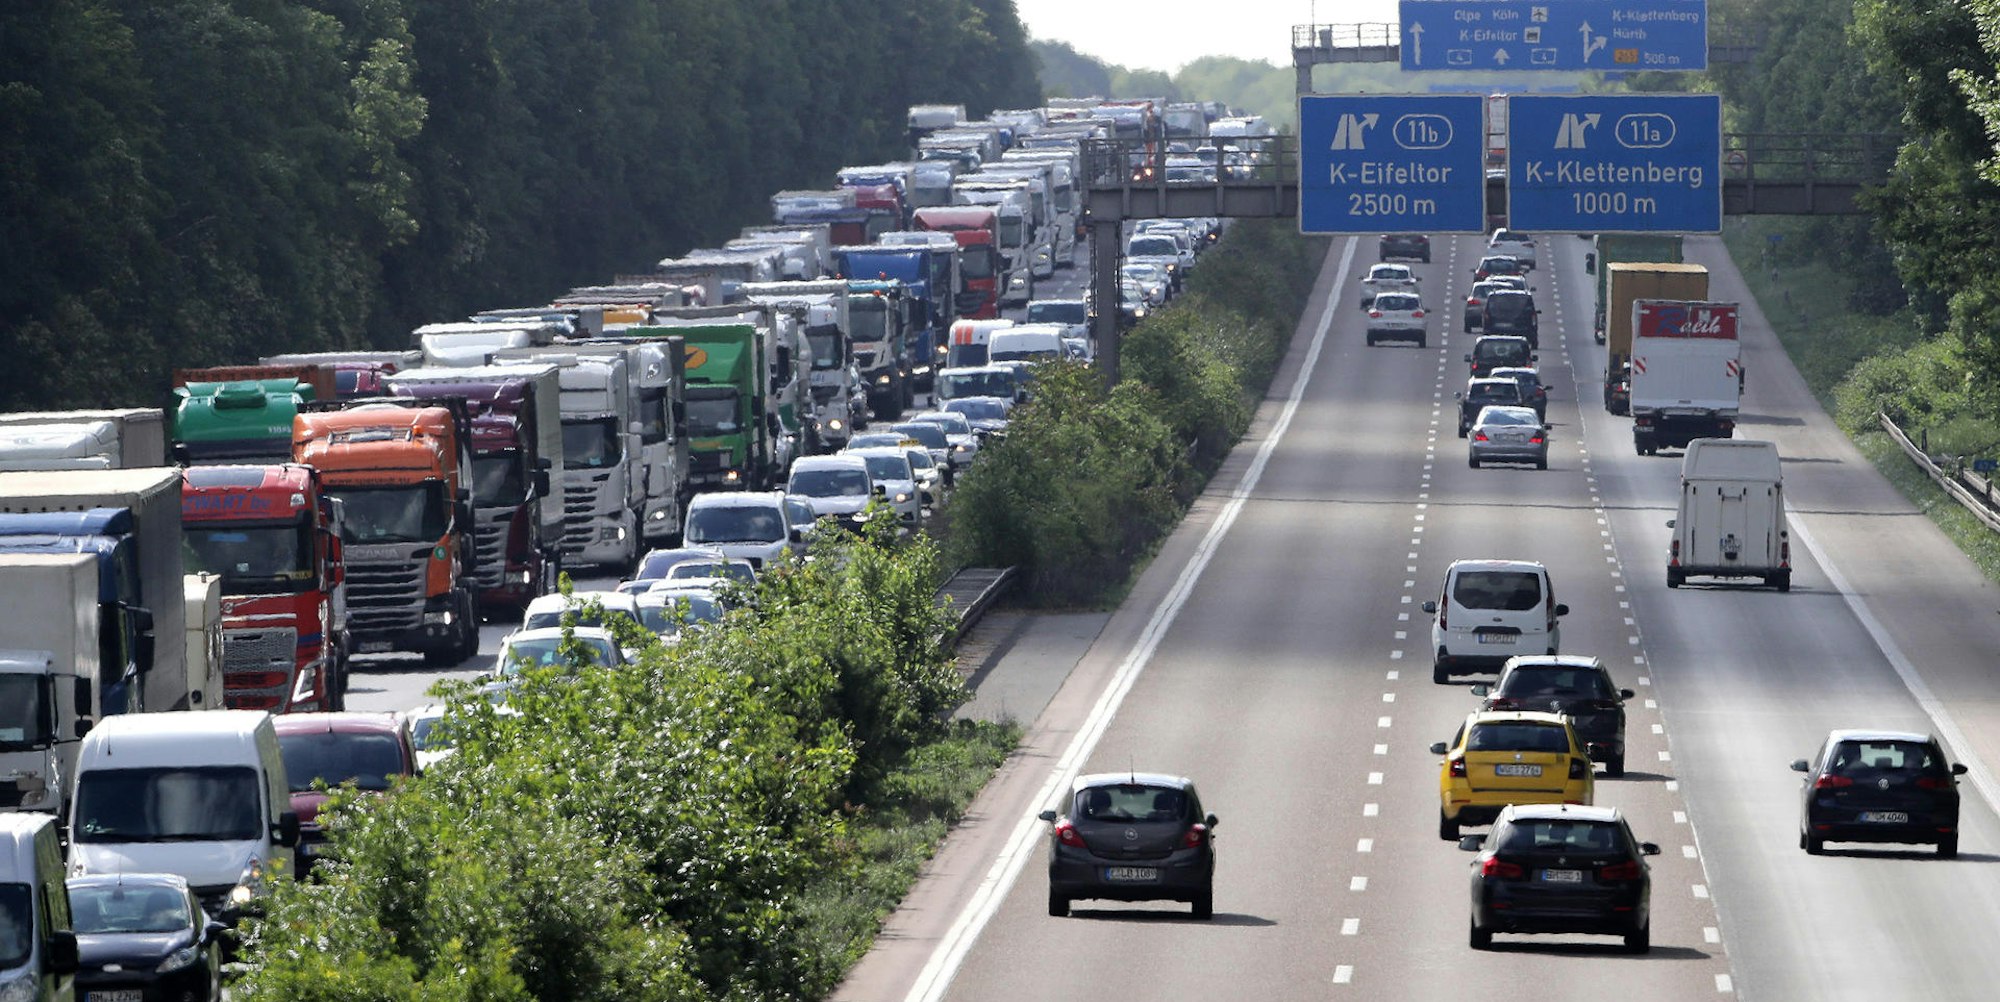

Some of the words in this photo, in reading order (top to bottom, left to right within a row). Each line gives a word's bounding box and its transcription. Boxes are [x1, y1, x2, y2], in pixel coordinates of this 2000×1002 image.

[1454, 10, 1481, 22] Olpe
[1492, 8, 1519, 20] Köln
[1612, 9, 1700, 24] K-Klettenberg
[1460, 29, 1518, 42] K-Eifeltor
[1644, 52, 1666, 64] 500
[1667, 55, 1681, 64] m
[1408, 120, 1438, 143] 11b
[1630, 121, 1661, 142] 11a
[1330, 162, 1453, 185] K-Eifeltor
[1526, 160, 1703, 189] K-Klettenberg
[1349, 194, 1407, 216] 2500
[1413, 200, 1436, 215] m
[1573, 192, 1627, 214] 1000
[1634, 199, 1656, 214] m
[344, 547, 398, 558] SCANIA
